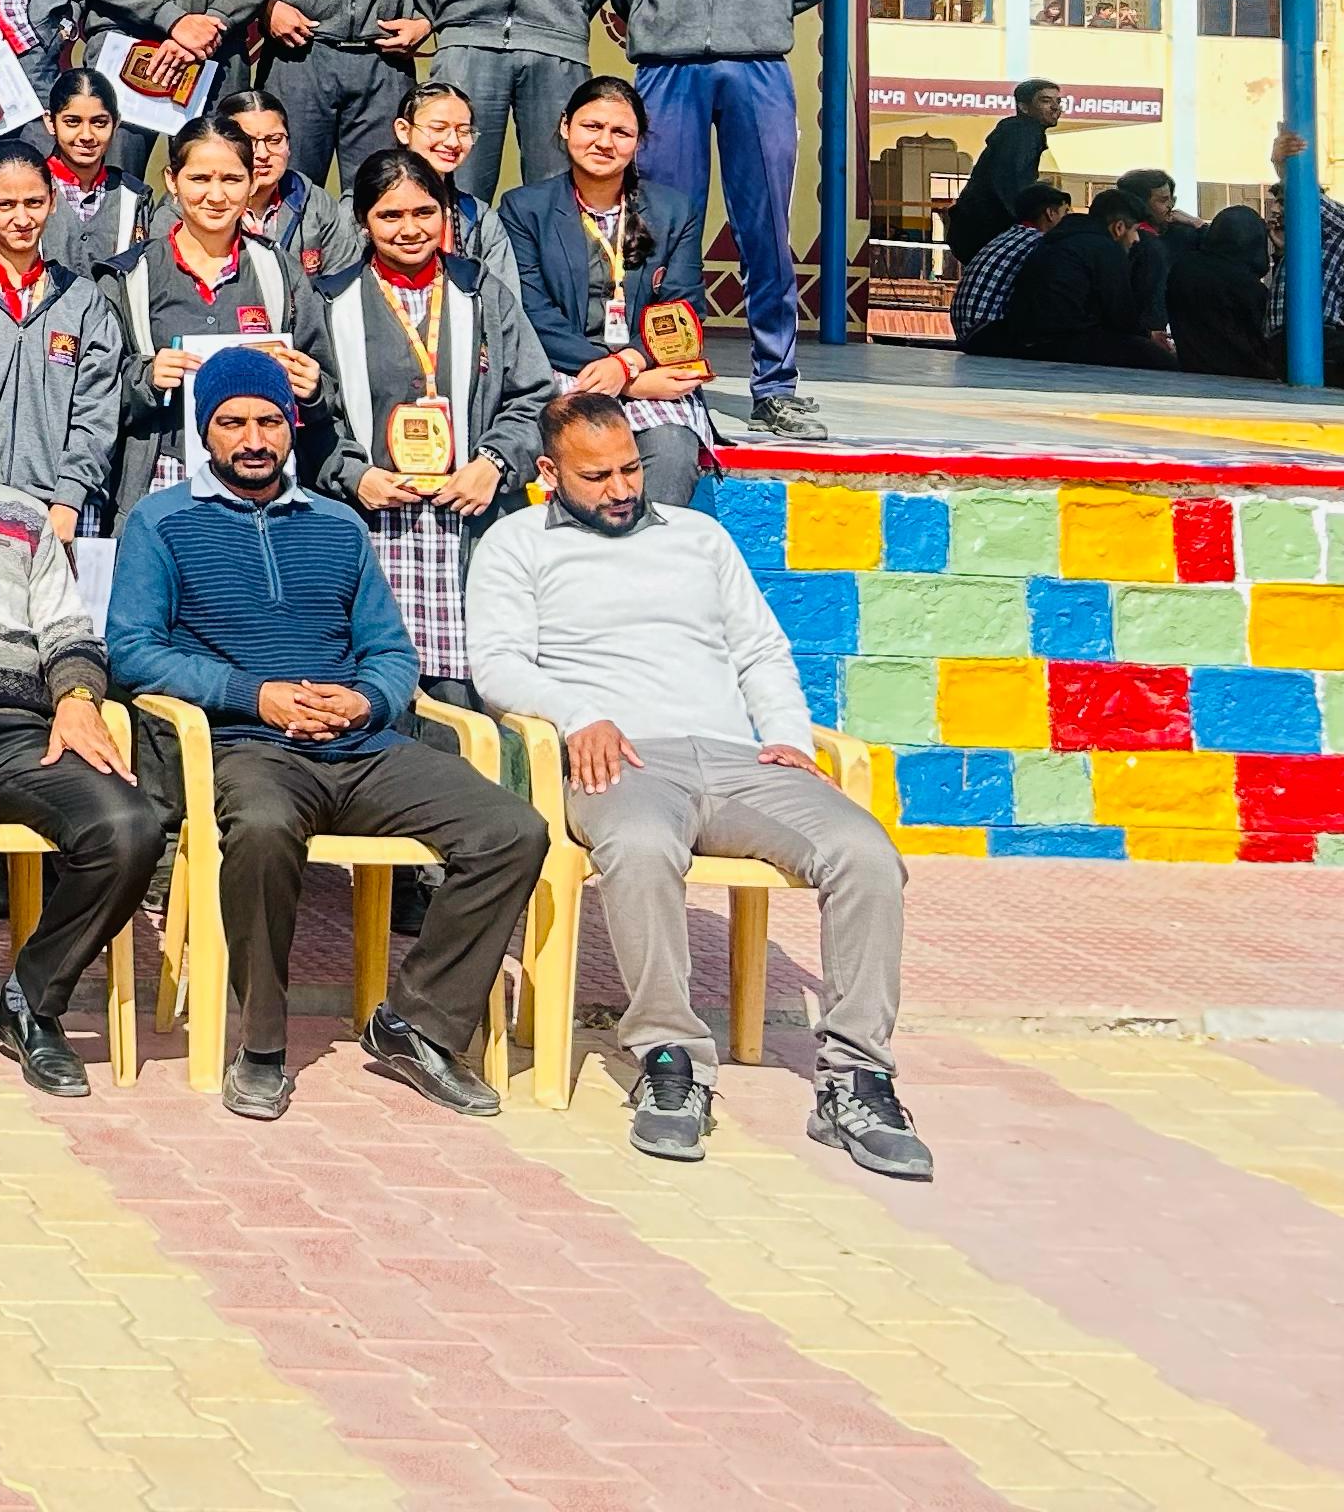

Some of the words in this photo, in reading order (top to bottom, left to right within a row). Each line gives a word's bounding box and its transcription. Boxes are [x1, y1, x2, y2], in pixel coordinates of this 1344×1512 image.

[869, 89, 906, 105] IYA
[914, 91, 1016, 109] VIDYALAY
[1076, 98, 1162, 116] JAISALMER
